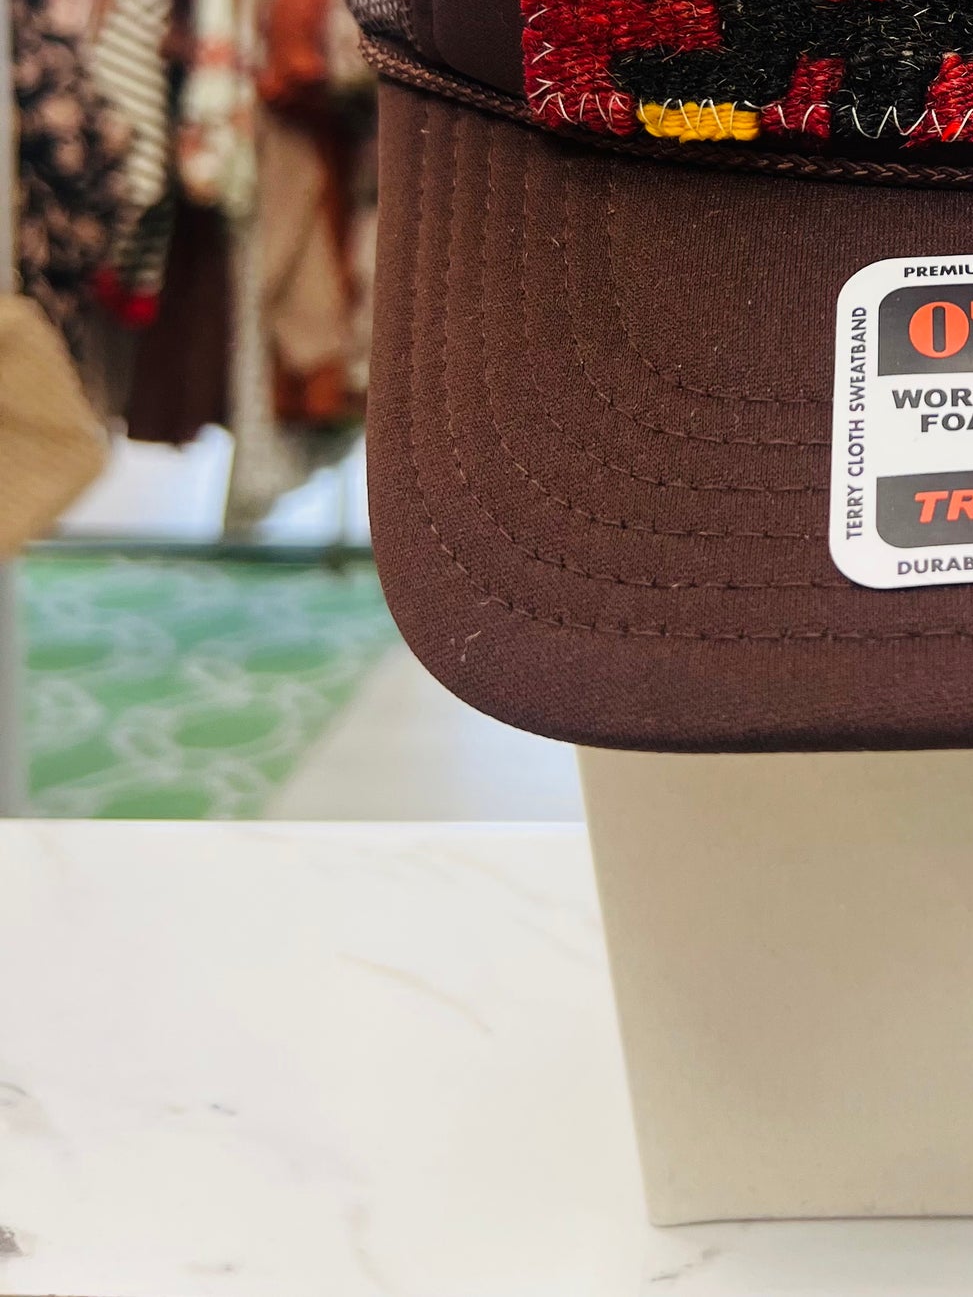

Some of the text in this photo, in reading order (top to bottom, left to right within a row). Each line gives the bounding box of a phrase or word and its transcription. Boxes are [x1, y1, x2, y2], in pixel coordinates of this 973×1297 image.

[846, 307, 867, 540] TERRY CLOTH SWEATBAND
